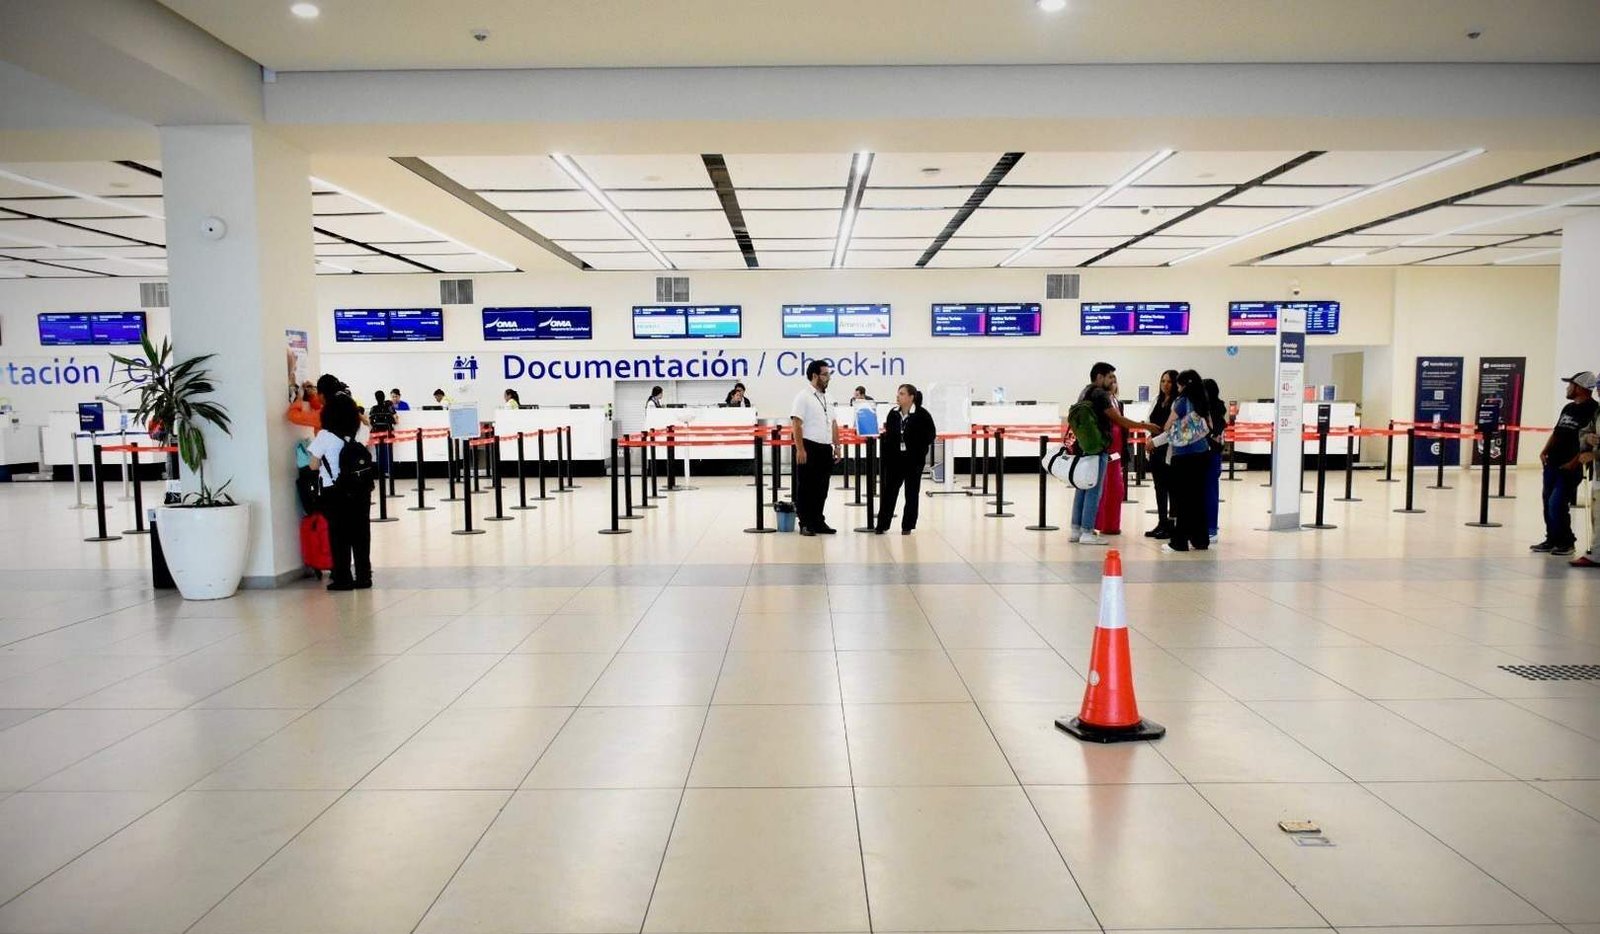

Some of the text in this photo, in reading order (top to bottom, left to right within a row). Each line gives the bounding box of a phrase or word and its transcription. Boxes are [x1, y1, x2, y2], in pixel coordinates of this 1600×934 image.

[0, 357, 101, 385] tación
[503, 350, 749, 380] Documentación
[757, 351, 767, 377] /
